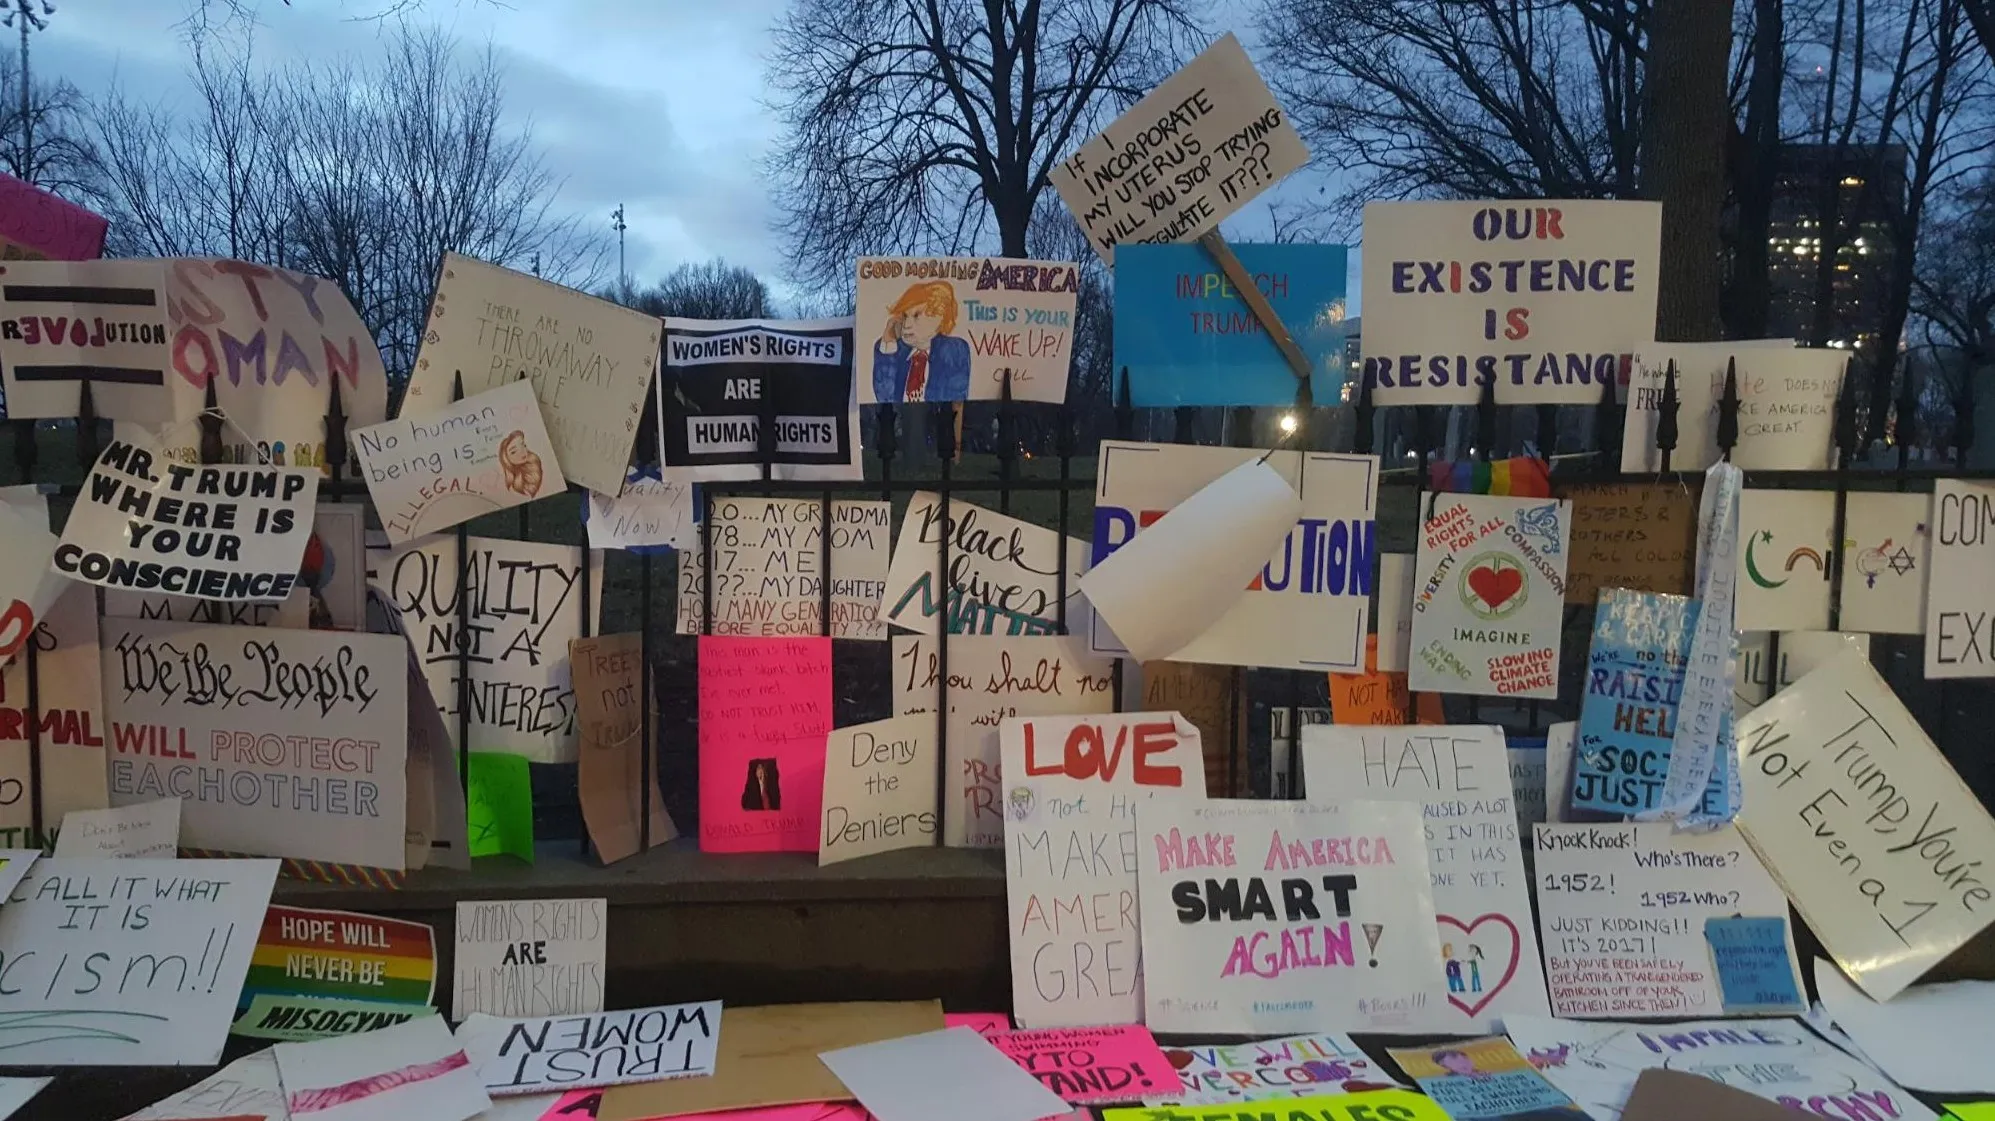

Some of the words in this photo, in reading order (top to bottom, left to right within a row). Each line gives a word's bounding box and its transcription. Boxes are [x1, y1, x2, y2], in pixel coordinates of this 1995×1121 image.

[1084, 88, 1213, 196] INCORPORATE
[1065, 153, 1086, 180] If
[1083, 200, 1112, 229] MY
[1114, 133, 1201, 203] UTERUS
[1098, 214, 1146, 250] WILL
[1142, 186, 1177, 218] YOU
[1175, 155, 1212, 195] STOP
[1213, 107, 1282, 163] TRYING
[1218, 141, 1273, 204] IT???
[1473, 207, 1565, 241] OUR
[168, 258, 327, 326] STY
[860, 260, 904, 280] GOOD
[976, 258, 1079, 293] AMERICA
[1176, 273, 1289, 299] IMPECH
[1392, 259, 1635, 294] EXISTENCE
[483, 299, 521, 323] THERE
[535, 314, 560, 335] ARE
[576, 326, 594, 345] NO
[963, 299, 999, 324] THIS
[1002, 307, 1018, 323] IS
[1024, 308, 1070, 328] YOUR
[1484, 306, 1530, 341] IS
[172, 323, 360, 390] OMAN
[475, 317, 620, 388] THROWAWAY
[673, 334, 760, 361] WOMEN'S
[766, 335, 836, 359] RIGHTS
[968, 329, 1022, 357] WAKE
[724, 378, 762, 400] ARE
[992, 367, 1034, 383] CLL
[1784, 377, 1818, 391] DOES
[360, 431, 398, 456] No
[411, 406, 495, 442] human
[695, 419, 760, 444] HUMAN
[774, 420, 832, 444] RIGHTS
[100, 440, 160, 483] MR.
[167, 464, 305, 501] TRUMP
[369, 453, 443, 484] being
[90, 472, 237, 530] WHERE
[254, 507, 295, 534] IS
[763, 503, 788, 523] MY
[1424, 504, 1468, 534] EQUAL
[127, 520, 241, 561] YOUR
[761, 527, 802, 547] MY
[915, 504, 1062, 577] Black
[1427, 516, 1475, 551] RIGHTS
[1450, 531, 1478, 553] FOR
[1480, 516, 1505, 539] ALL
[765, 550, 815, 573] ME
[1091, 506, 1375, 597] RUTION
[1504, 526, 1566, 597] COMPASSION
[54, 544, 296, 598] CONSCIENCE
[760, 577, 792, 598] MY
[727, 600, 776, 622] MANY
[500, 628, 541, 667] A
[1453, 627, 1531, 645] IMAGINE
[115, 631, 182, 706] We
[237, 640, 379, 718] People
[984, 650, 1061, 696] shalt
[1419, 648, 1446, 675] WAR
[1429, 640, 1472, 681] ENDING
[1487, 648, 1554, 671] SLOWING
[1489, 661, 1549, 683] CLIMATE
[602, 676, 636, 712] not
[1348, 682, 1378, 708] NOT
[1496, 675, 1555, 696] CHANGE
[1590, 668, 1681, 706] RAISI
[1614, 703, 1675, 739] HEL
[113, 722, 197, 759] WILL
[210, 730, 381, 773] PROTECT
[852, 732, 917, 768] Deny
[1023, 721, 1183, 788] LOVE
[1362, 735, 1481, 791] HATE
[112, 761, 380, 817] EACHOTHER
[865, 772, 899, 795] the
[1423, 799, 1468, 819] AUSED
[1747, 720, 1811, 789] Not
[1799, 788, 1863, 876] Even
[1859, 878, 1886, 907] a
[827, 807, 938, 847] Deniers
[1447, 824, 1473, 841] IN
[1479, 823, 1516, 841] THIS
[1537, 827, 1587, 851] Knock
[1016, 829, 1139, 880] MAKE
[1471, 848, 1507, 863] HAS
[1634, 851, 1683, 869] Who's
[110, 877, 148, 900] IT
[155, 877, 230, 902] WHAT
[1171, 874, 1358, 925] SMART
[1545, 873, 1616, 895] 1952!
[1640, 890, 1691, 908] 1952
[1693, 890, 1740, 909] Who?
[58, 905, 109, 930] IT
[121, 905, 152, 931] IS
[532, 901, 601, 942] RIGHTS
[1021, 890, 1138, 936] AMER
[1551, 916, 1594, 934] JUST
[1601, 917, 1689, 936] KIDDING!!
[281, 915, 335, 942] HOPE
[341, 922, 391, 949] WILL
[1562, 937, 1591, 953] IT'S
[1598, 937, 1656, 954] 2017!
[286, 953, 356, 982] NEVER
[359, 959, 386, 986] BE
[502, 940, 548, 966] ARE
[460, 966, 526, 1017] HUMAN
[532, 962, 602, 1018] RIGHTS
[1557, 999, 1609, 1014] KITCHEN
[1611, 999, 1646, 1012] SINCE
[498, 1006, 710, 1057] WOMEN
[485, 1038, 706, 1089] TRUST
